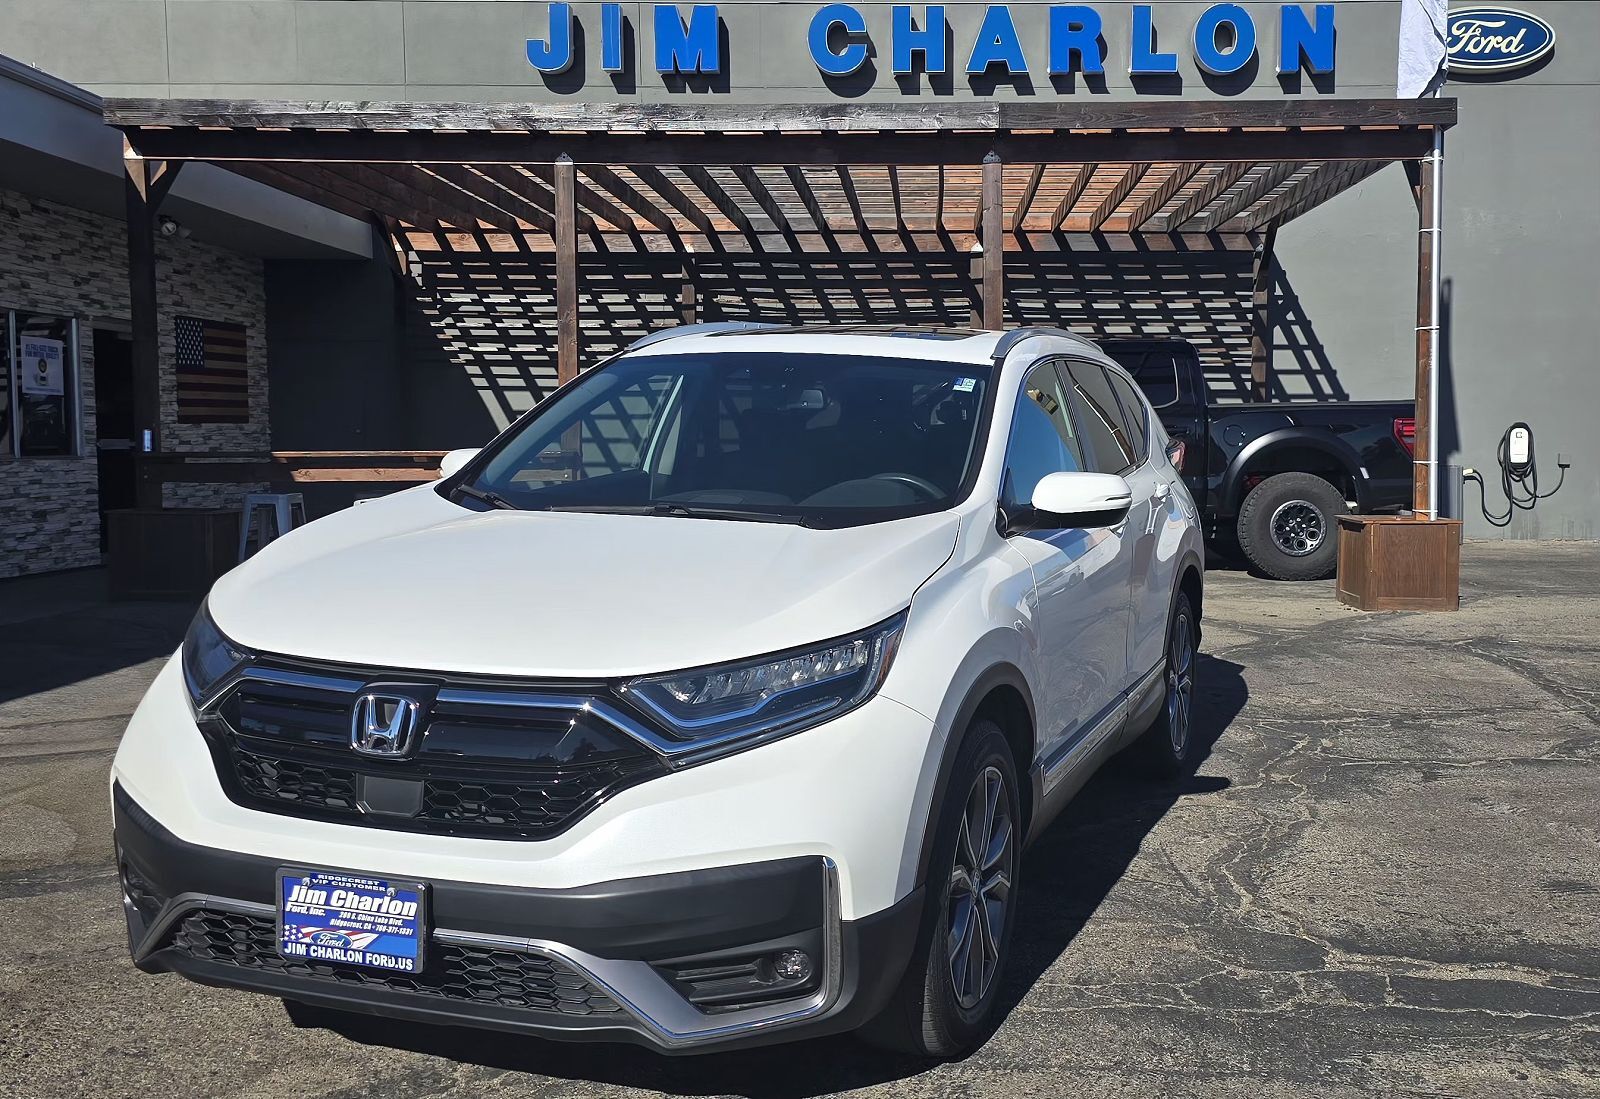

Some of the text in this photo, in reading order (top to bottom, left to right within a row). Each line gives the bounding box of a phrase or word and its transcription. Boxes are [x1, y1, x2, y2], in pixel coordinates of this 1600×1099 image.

[526, 2, 1335, 76] JIM CHARLON
[1447, 20, 1527, 54] Ford
[317, 874, 380, 886] RIDGECREST
[331, 880, 386, 892] CUSTOMER
[288, 885, 418, 916] Jim Charlon
[309, 906, 326, 917] Inc.
[317, 932, 346, 947] Ford
[284, 942, 414, 971] JIM CHARLON FORD.US
